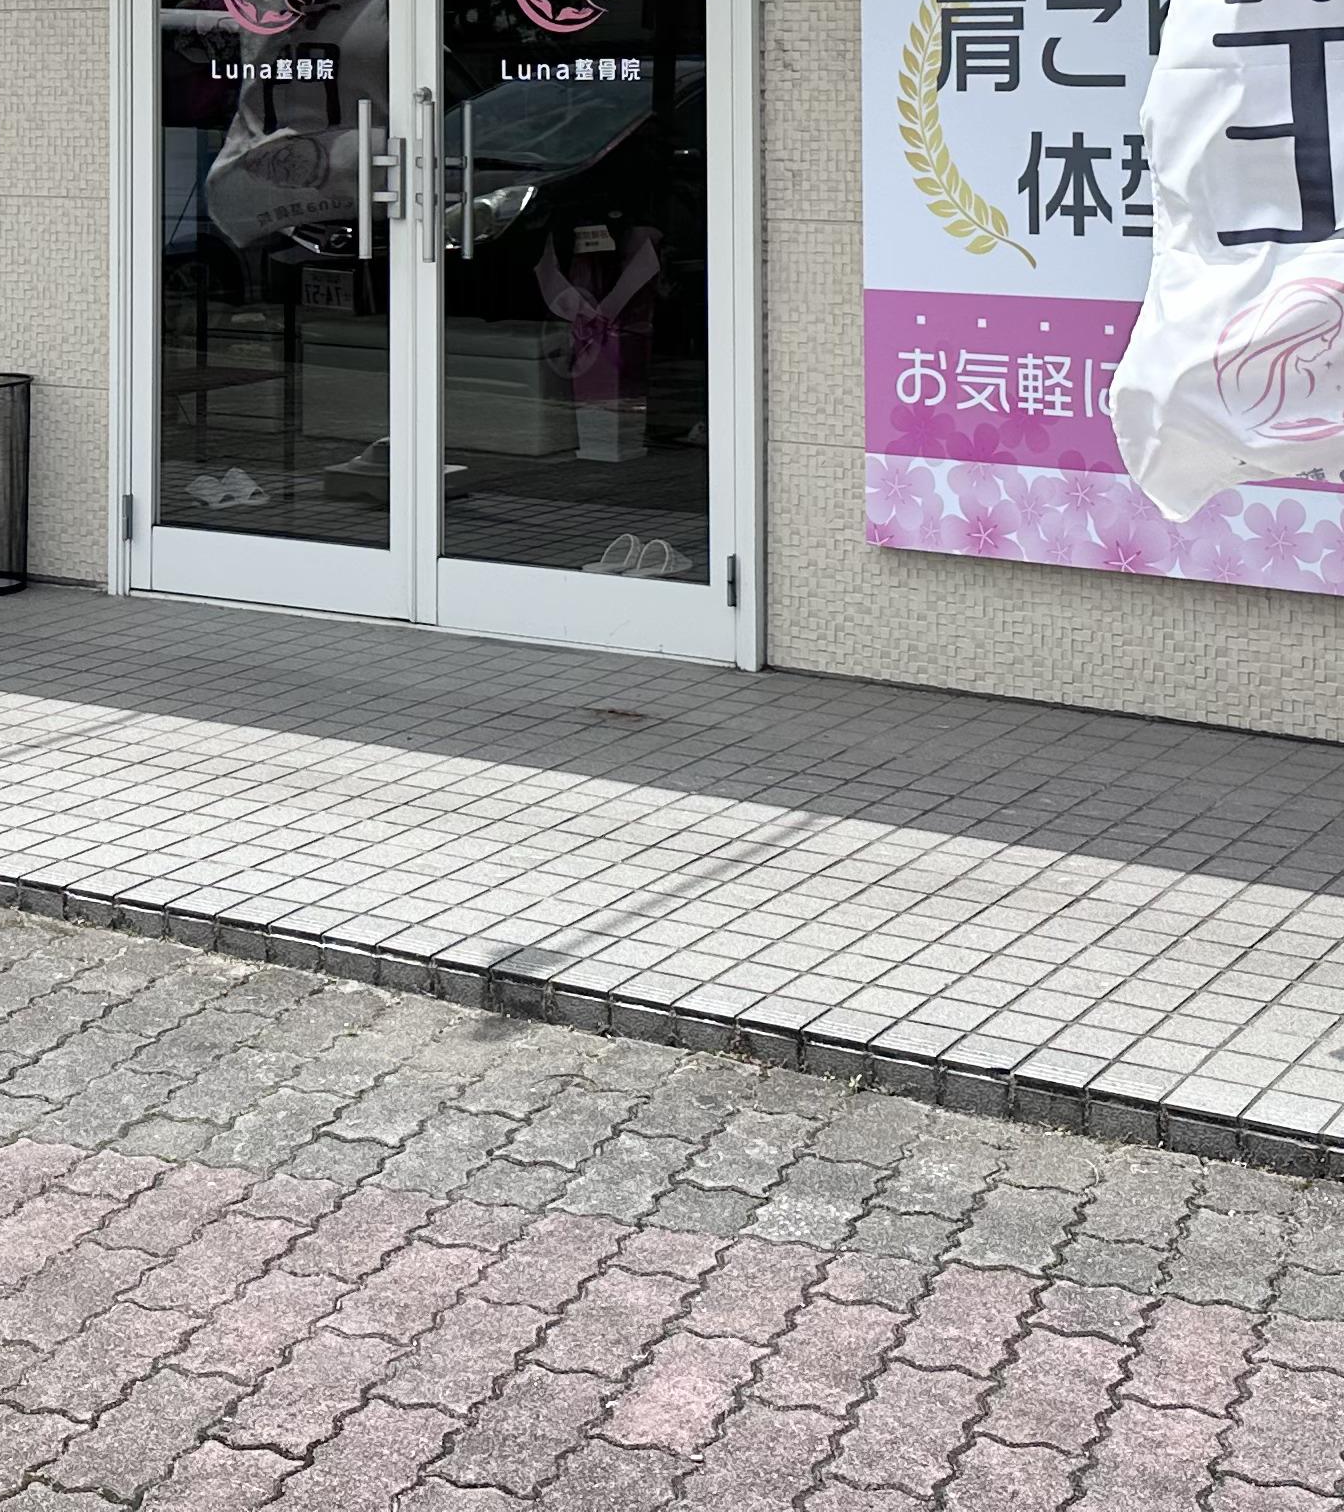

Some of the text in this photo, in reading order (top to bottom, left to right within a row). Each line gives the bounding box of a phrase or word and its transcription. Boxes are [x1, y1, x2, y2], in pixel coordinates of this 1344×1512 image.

[211, 58, 335, 80] Luna整骨院
[501, 58, 642, 82] Luna整骨院
